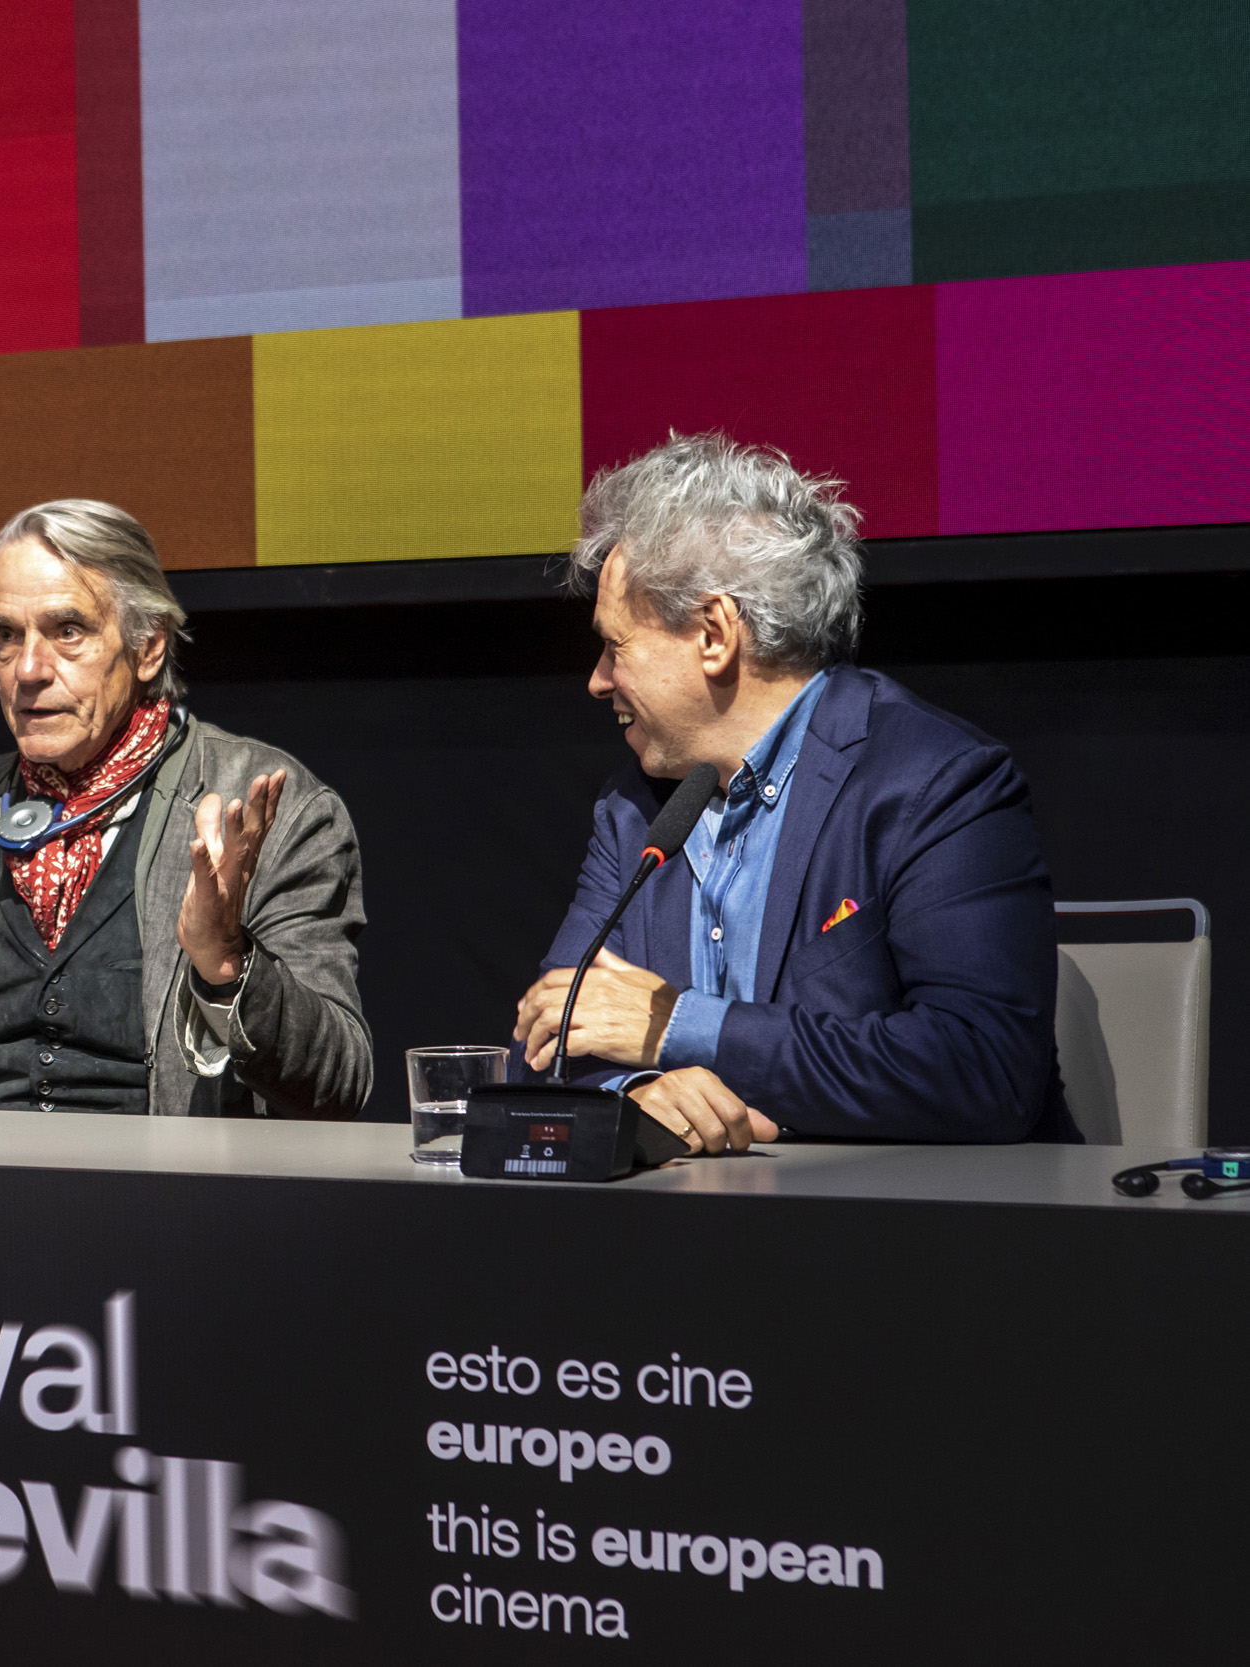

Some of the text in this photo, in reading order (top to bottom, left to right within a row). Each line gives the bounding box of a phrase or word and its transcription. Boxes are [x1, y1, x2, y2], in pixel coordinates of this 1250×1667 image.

[425, 1344, 754, 1410] esto es cine
[426, 1420, 672, 1483] europeo
[426, 1501, 885, 1592] this is european
[430, 1572, 630, 1640] cinema
